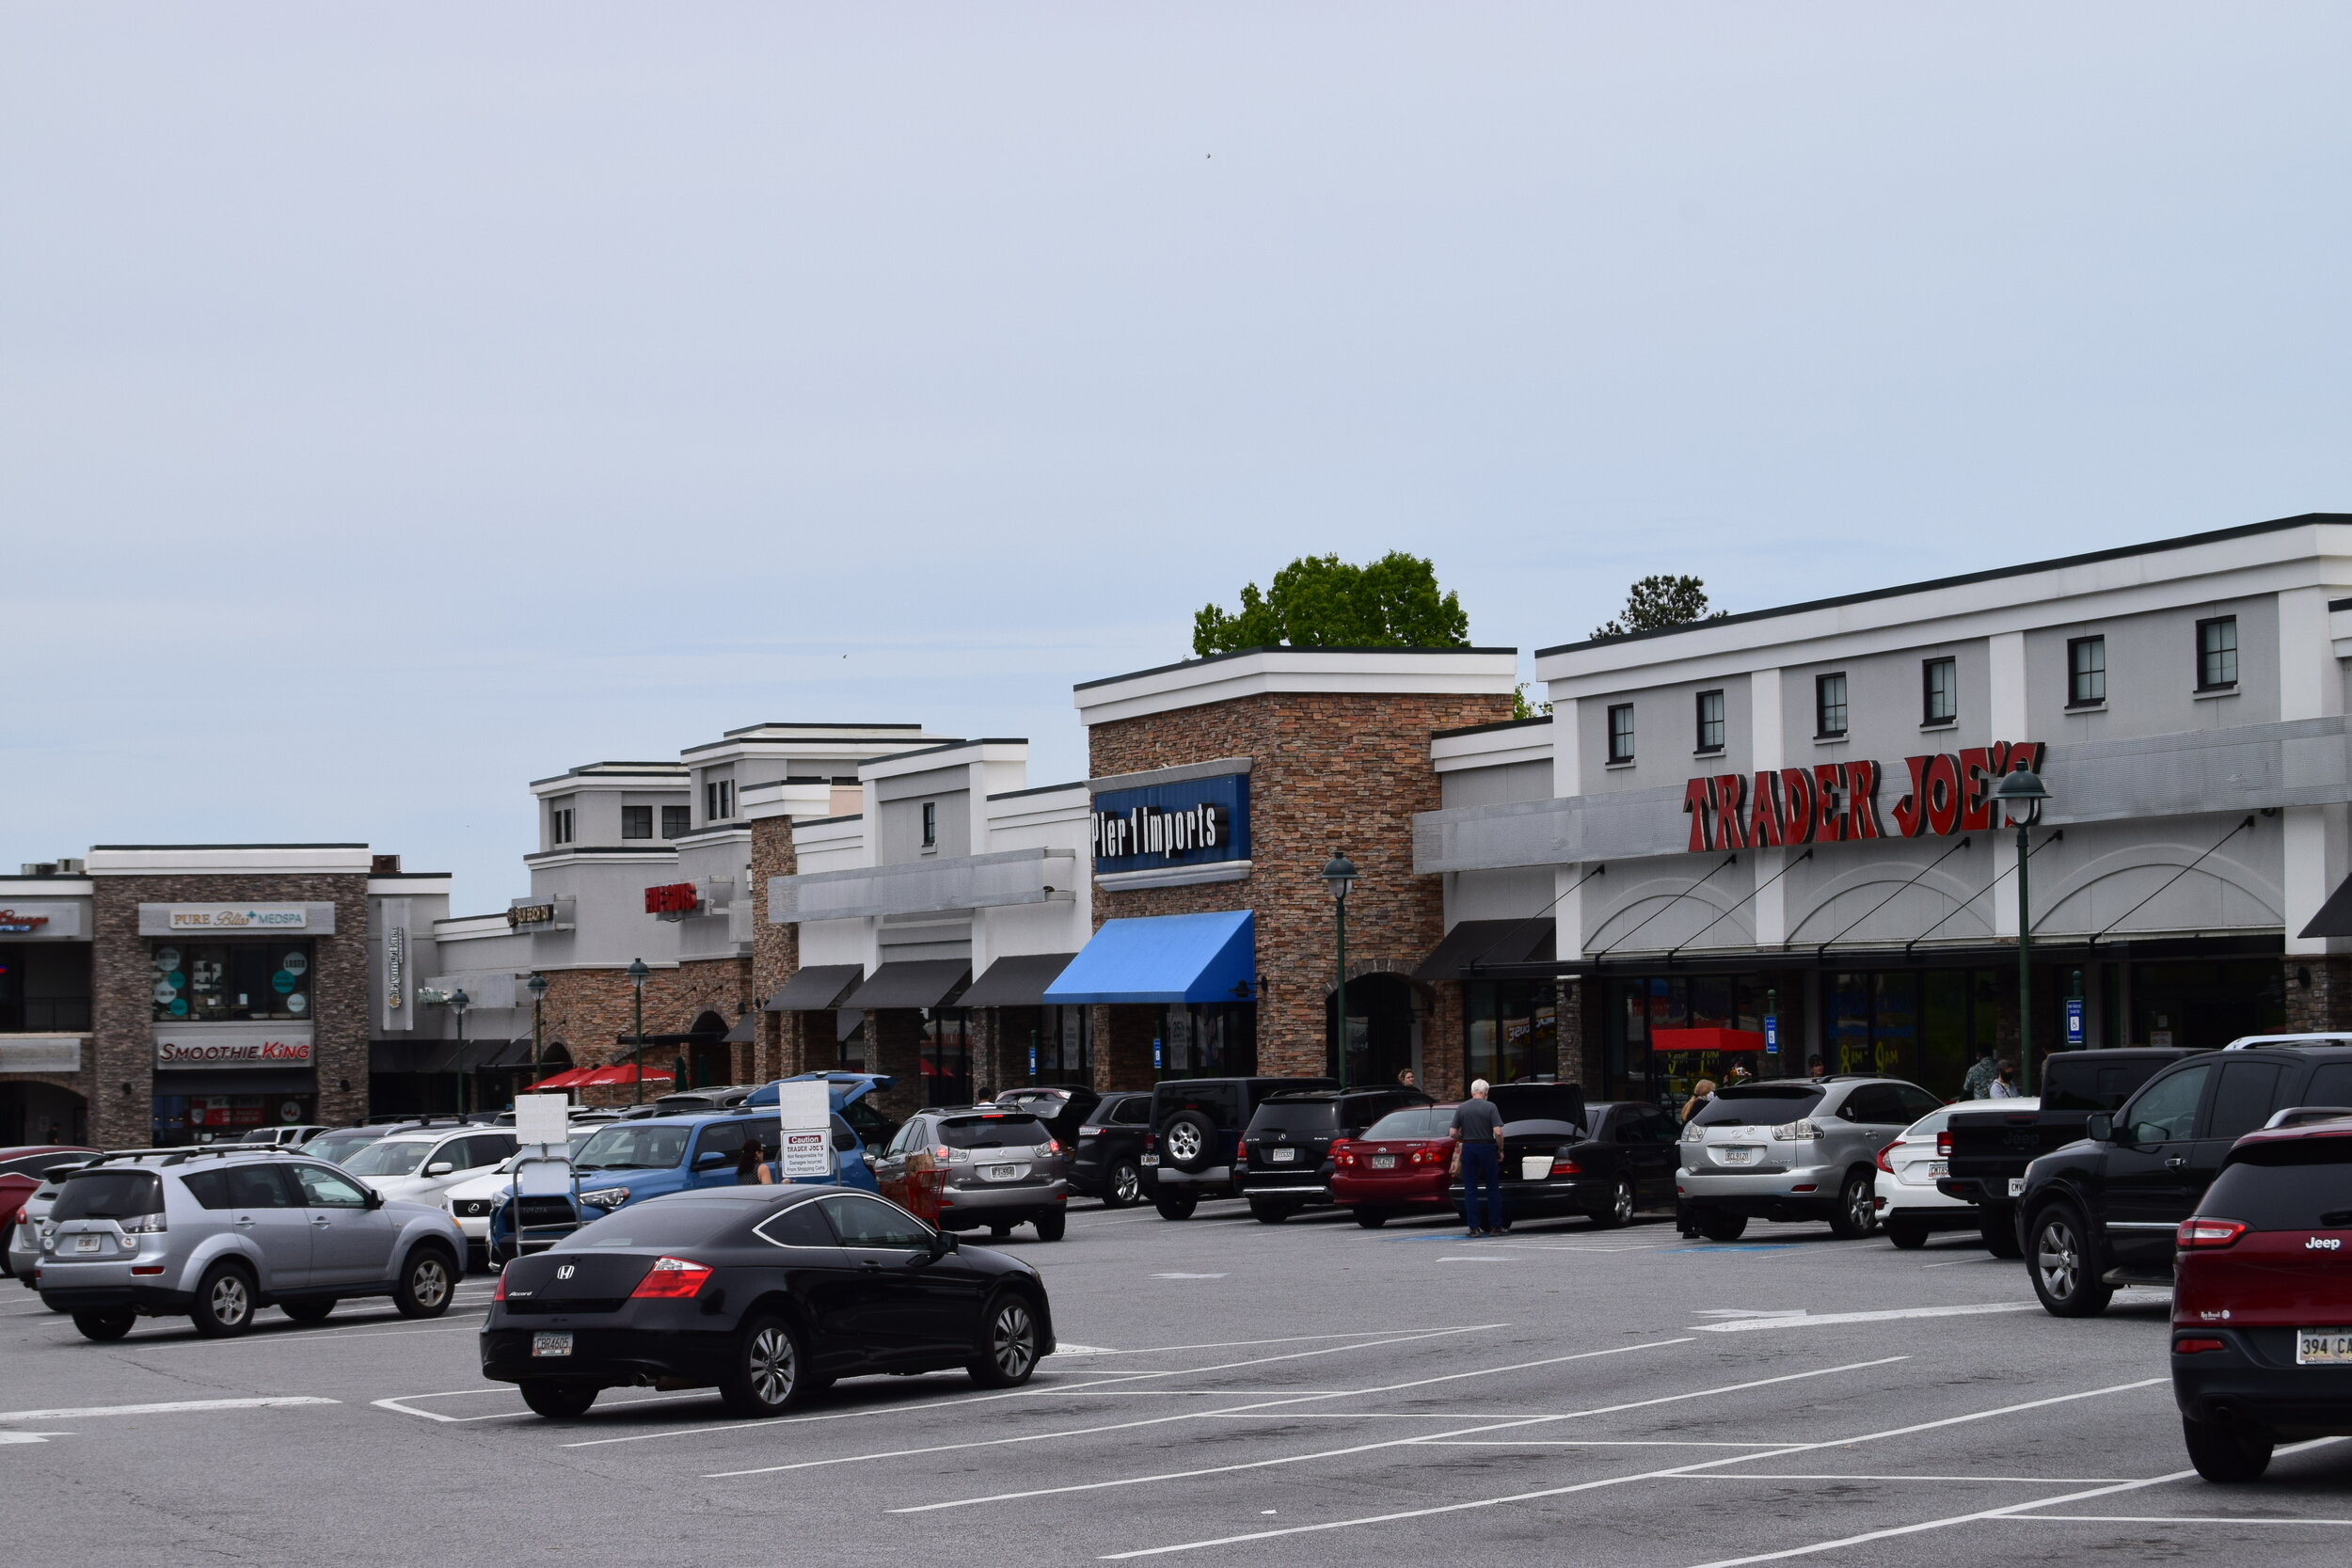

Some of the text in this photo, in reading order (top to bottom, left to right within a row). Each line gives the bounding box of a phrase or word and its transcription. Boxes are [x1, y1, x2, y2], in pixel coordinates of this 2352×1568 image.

[1683, 760, 1883, 852] TRADER
[1090, 803, 1216, 859] Pier 1 imports
[174, 911, 302, 926] PURE Bliss MEDSPA
[285, 958, 306, 969] LASER
[160, 1043, 260, 1061] SMOOTHIE
[2002, 1130, 2040, 1145] Jeep
[2305, 1236, 2341, 1251] Jeep
[536, 1338, 569, 1350] CBR4605
[2302, 1338, 2328, 1354] 394
